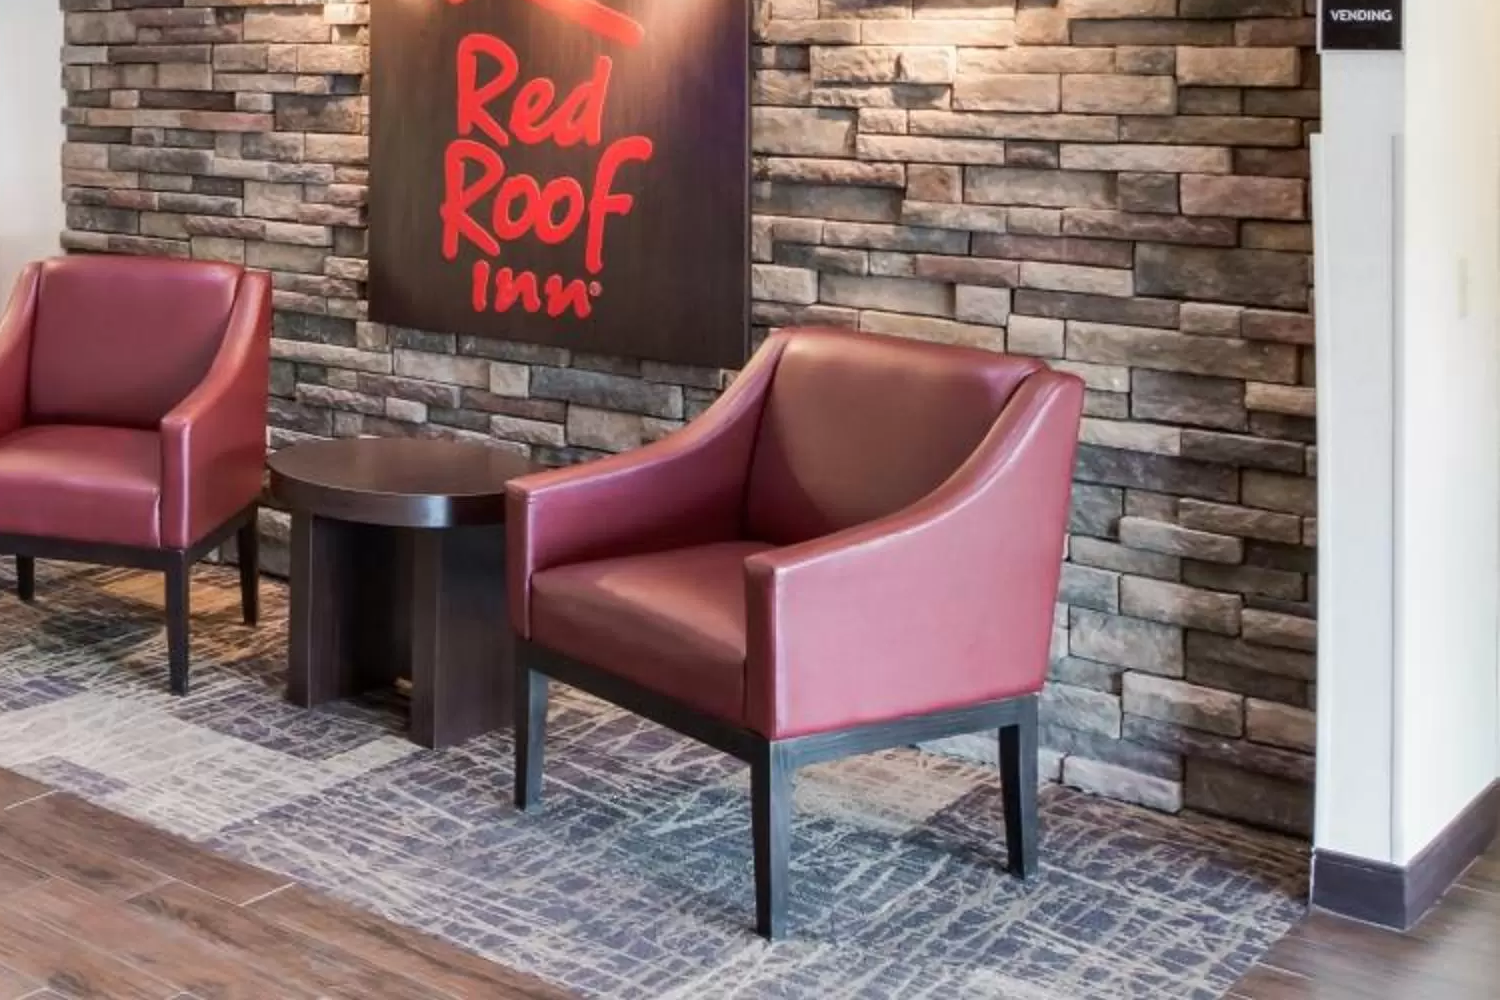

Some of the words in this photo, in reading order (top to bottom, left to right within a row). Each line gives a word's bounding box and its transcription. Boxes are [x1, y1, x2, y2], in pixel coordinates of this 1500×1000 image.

[1329, 8, 1393, 22] VENDING
[457, 33, 612, 147] Red
[440, 136, 653, 274] Roof
